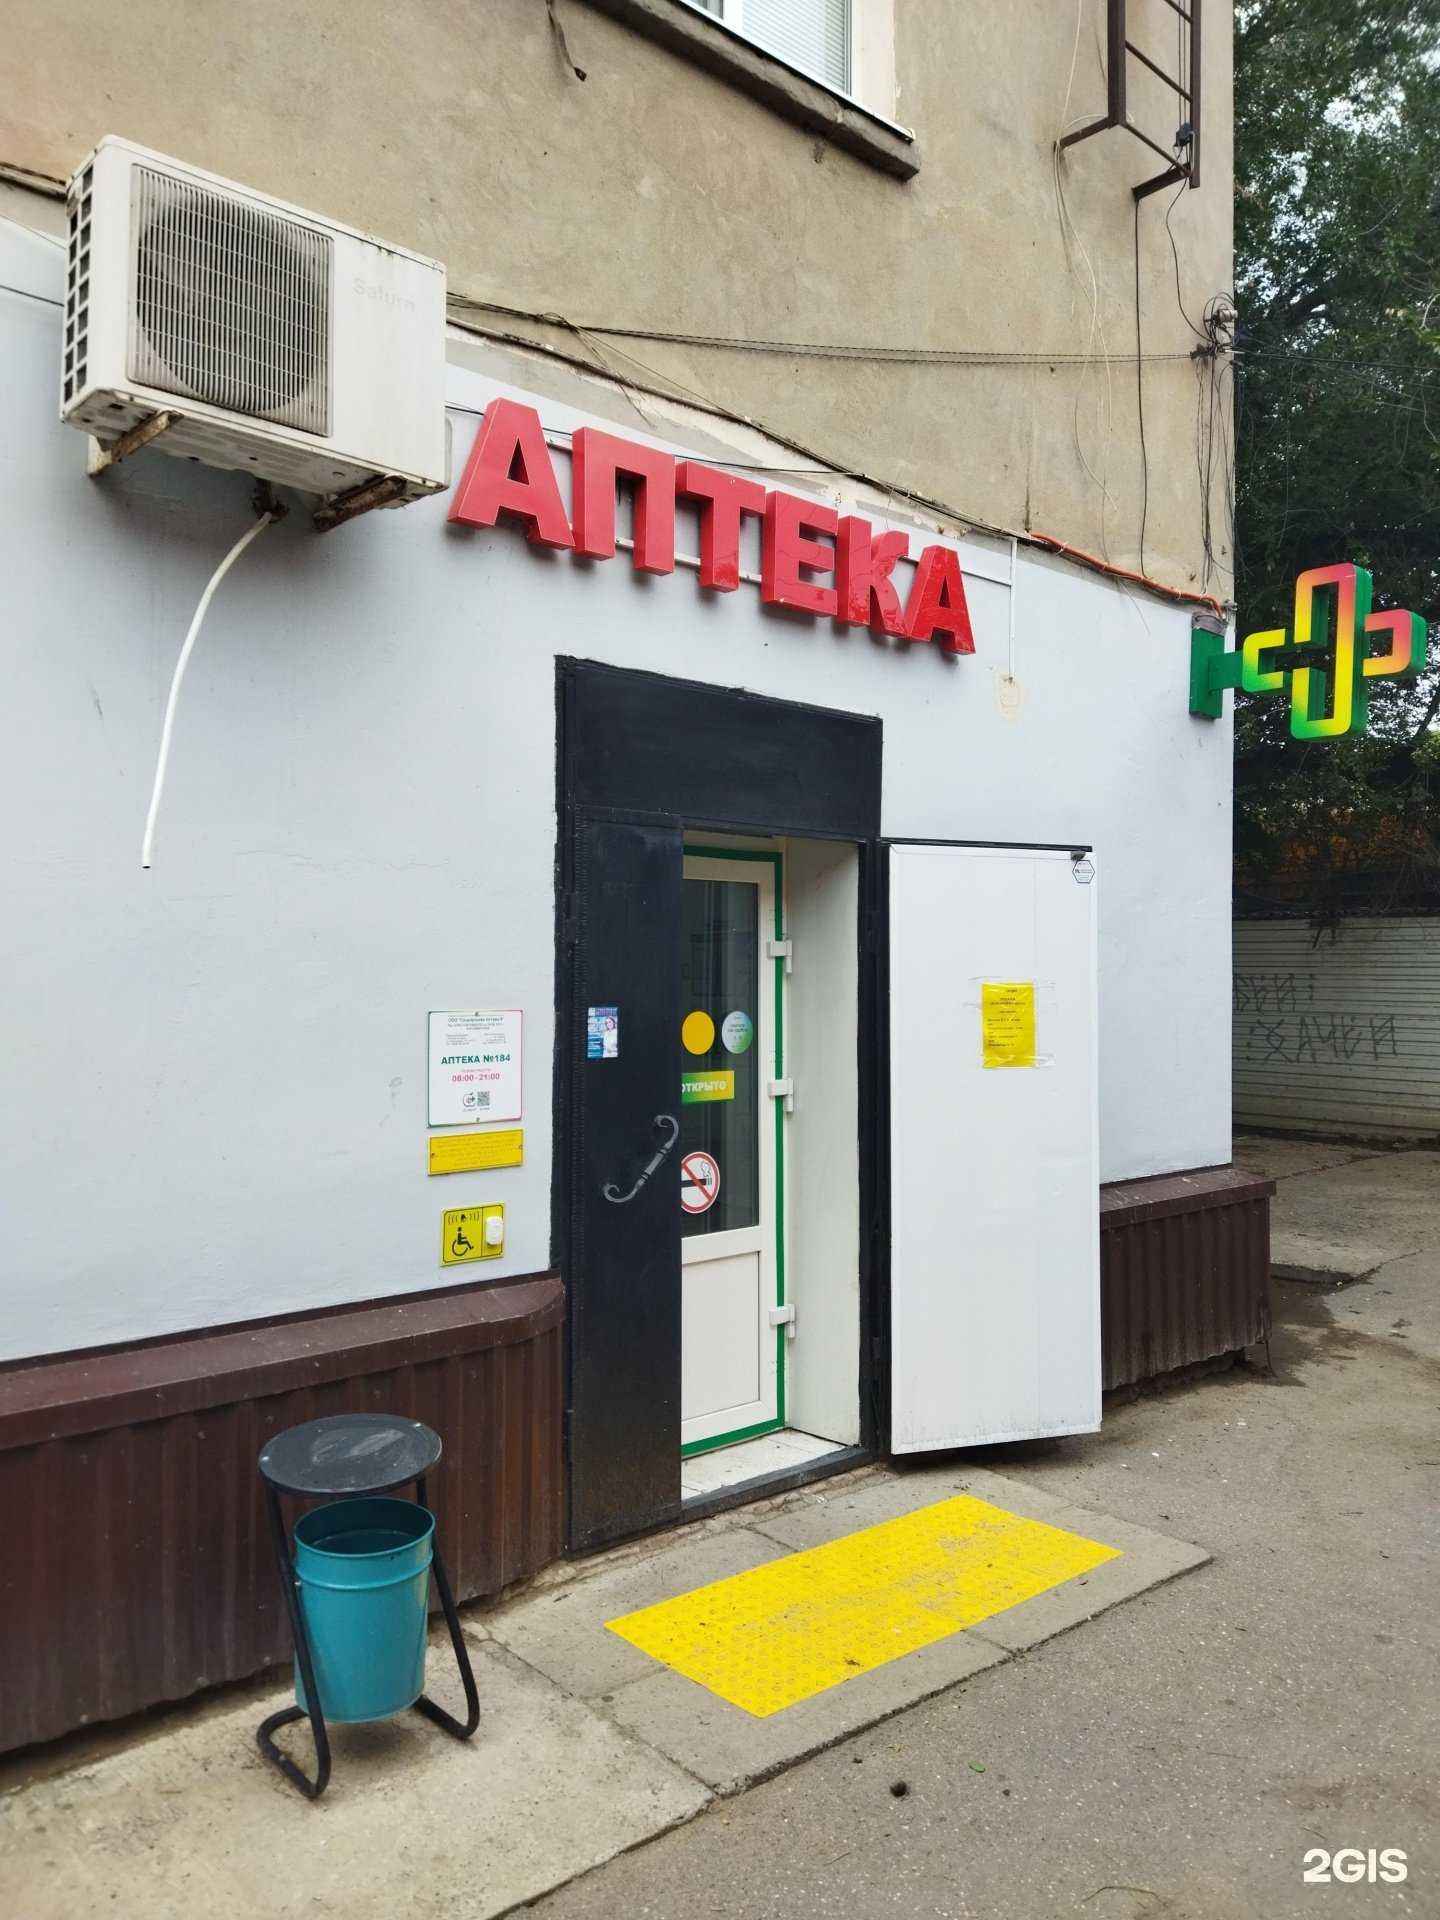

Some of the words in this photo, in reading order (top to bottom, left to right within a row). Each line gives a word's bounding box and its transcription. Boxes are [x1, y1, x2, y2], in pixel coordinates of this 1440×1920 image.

[353, 277, 415, 312] Saturn
[447, 397, 975, 655] АПТЕКА
[441, 1055, 480, 1065] АПТЕКА
[483, 1053, 511, 1063] №184
